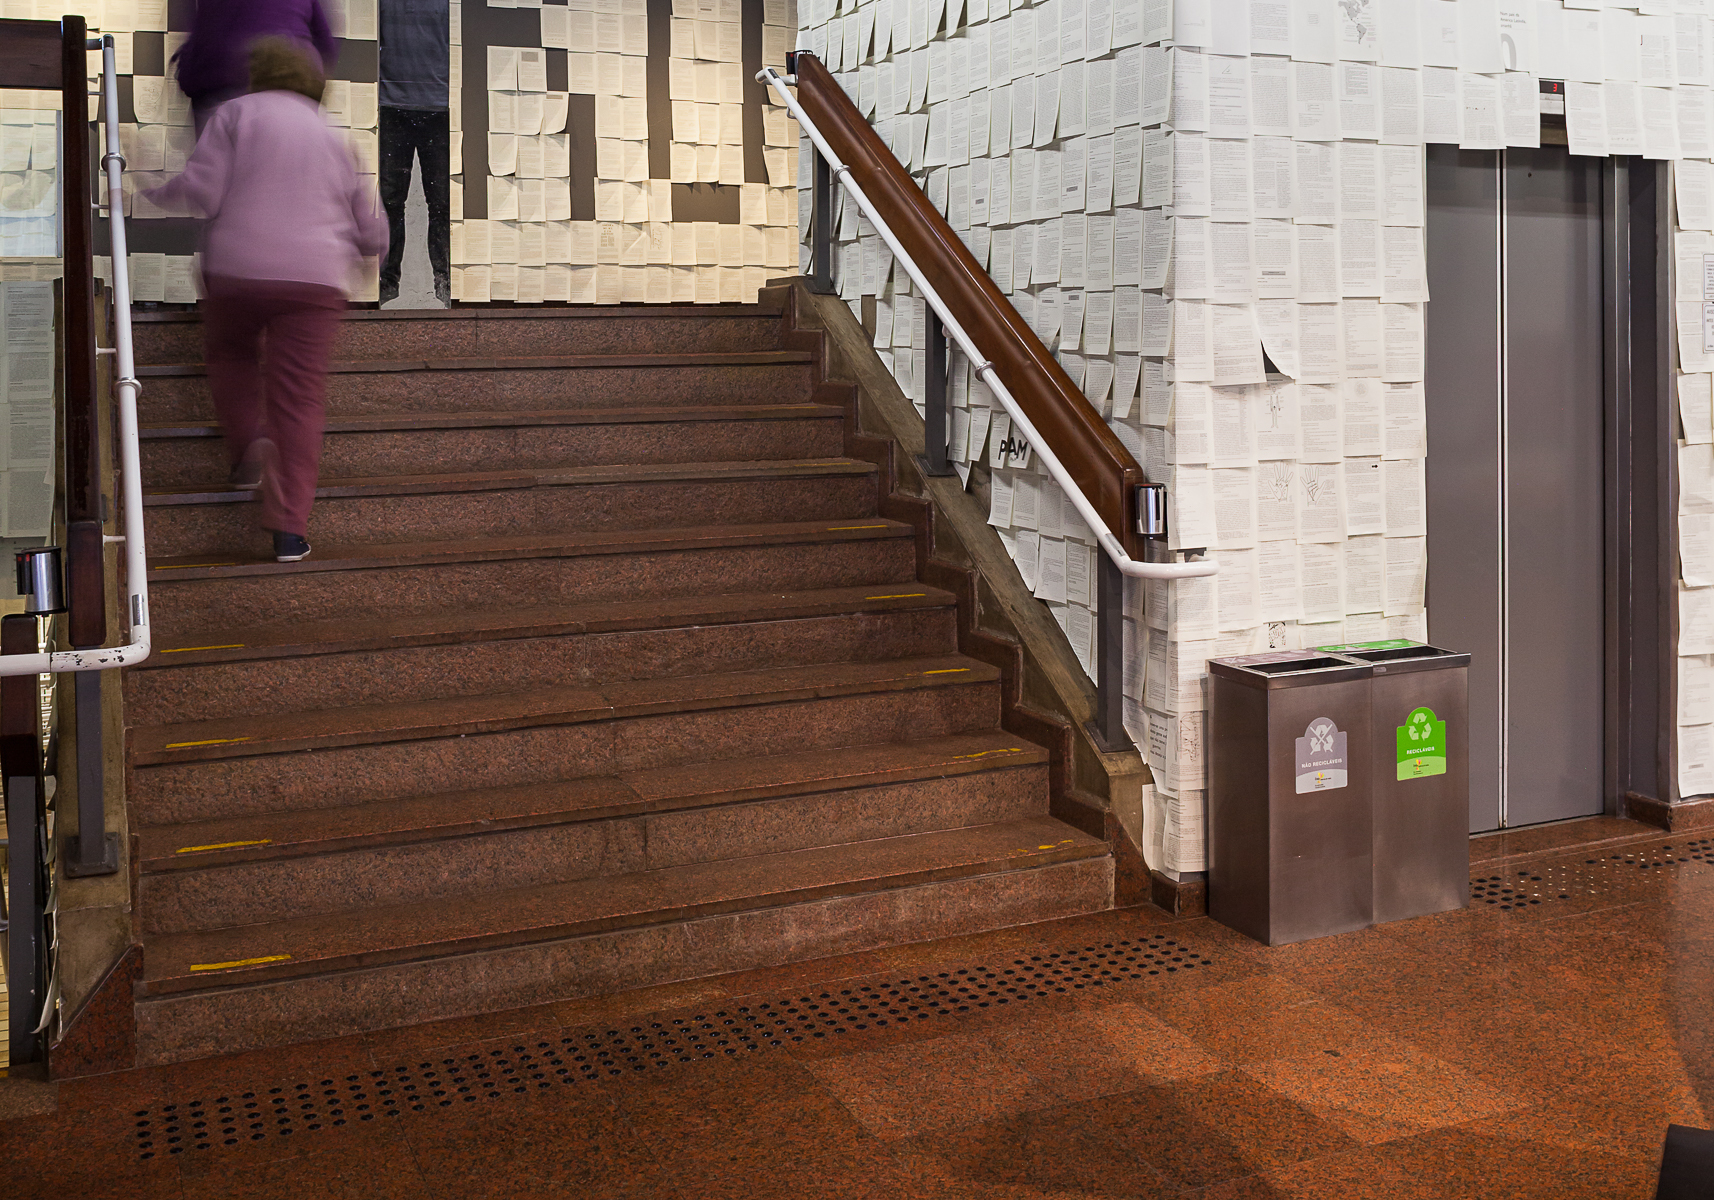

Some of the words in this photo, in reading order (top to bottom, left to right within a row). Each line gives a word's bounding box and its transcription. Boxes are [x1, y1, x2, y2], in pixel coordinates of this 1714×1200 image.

[1553, 83, 1558, 92] 3
[998, 437, 1028, 460] PAM
[1406, 746, 1435, 754] RECICLÁVEIS
[1313, 758, 1342, 766] RECICLÁVEIS
